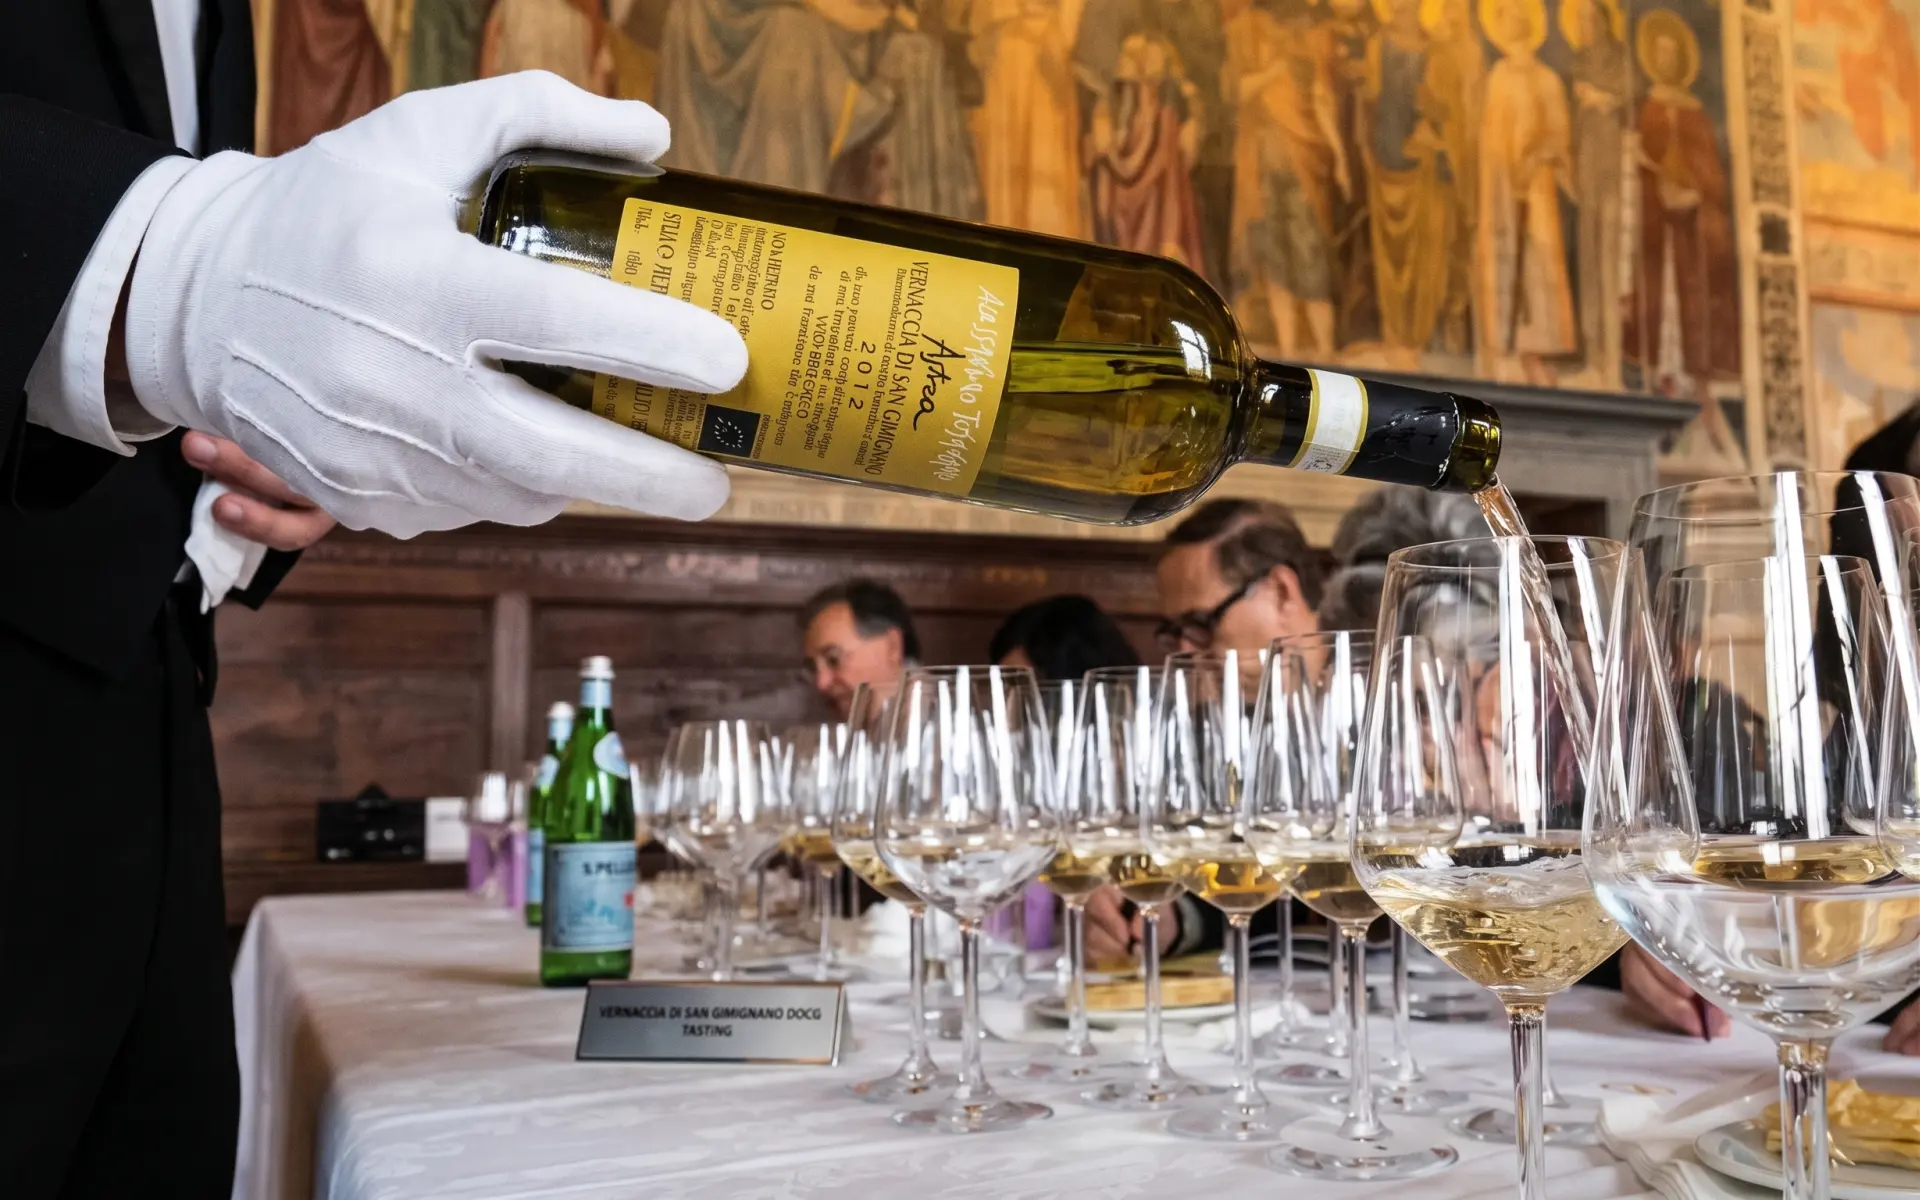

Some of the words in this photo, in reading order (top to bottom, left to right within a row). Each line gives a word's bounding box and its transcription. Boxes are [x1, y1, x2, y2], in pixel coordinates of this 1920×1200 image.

[898, 262, 928, 346] VERNACCIA
[848, 340, 875, 409] 2012
[894, 351, 914, 370] DI
[887, 373, 909, 405] SAN
[864, 409, 901, 474] GIMIGNANO
[599, 1006, 665, 1019] VERNACCIA
[669, 1006, 682, 1019] DI
[684, 1006, 708, 1019] SAN
[711, 1006, 783, 1020] GIMIGNANO
[786, 1008, 821, 1020] DOCG
[682, 1024, 732, 1037] TASTING
